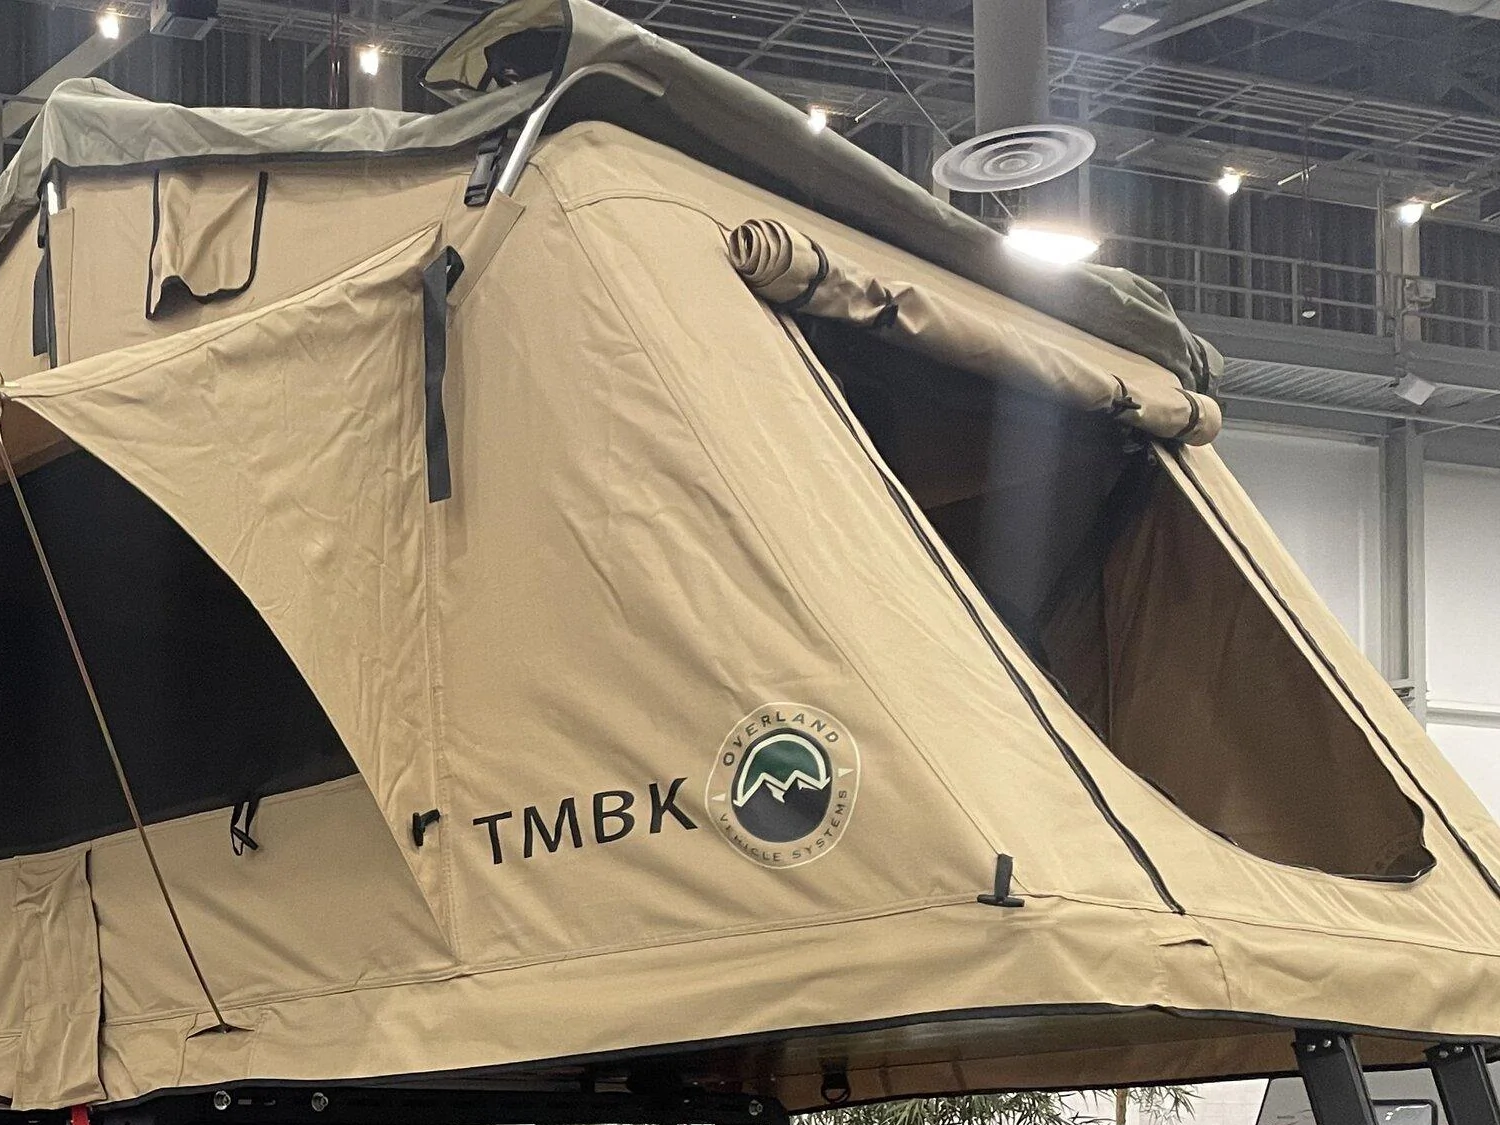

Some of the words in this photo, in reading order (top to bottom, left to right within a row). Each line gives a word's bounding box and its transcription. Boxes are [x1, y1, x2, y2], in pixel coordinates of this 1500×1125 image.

[723, 711, 839, 766] OVERLAND
[472, 777, 698, 865] TMBK
[792, 790, 848, 859] SYSTEMS
